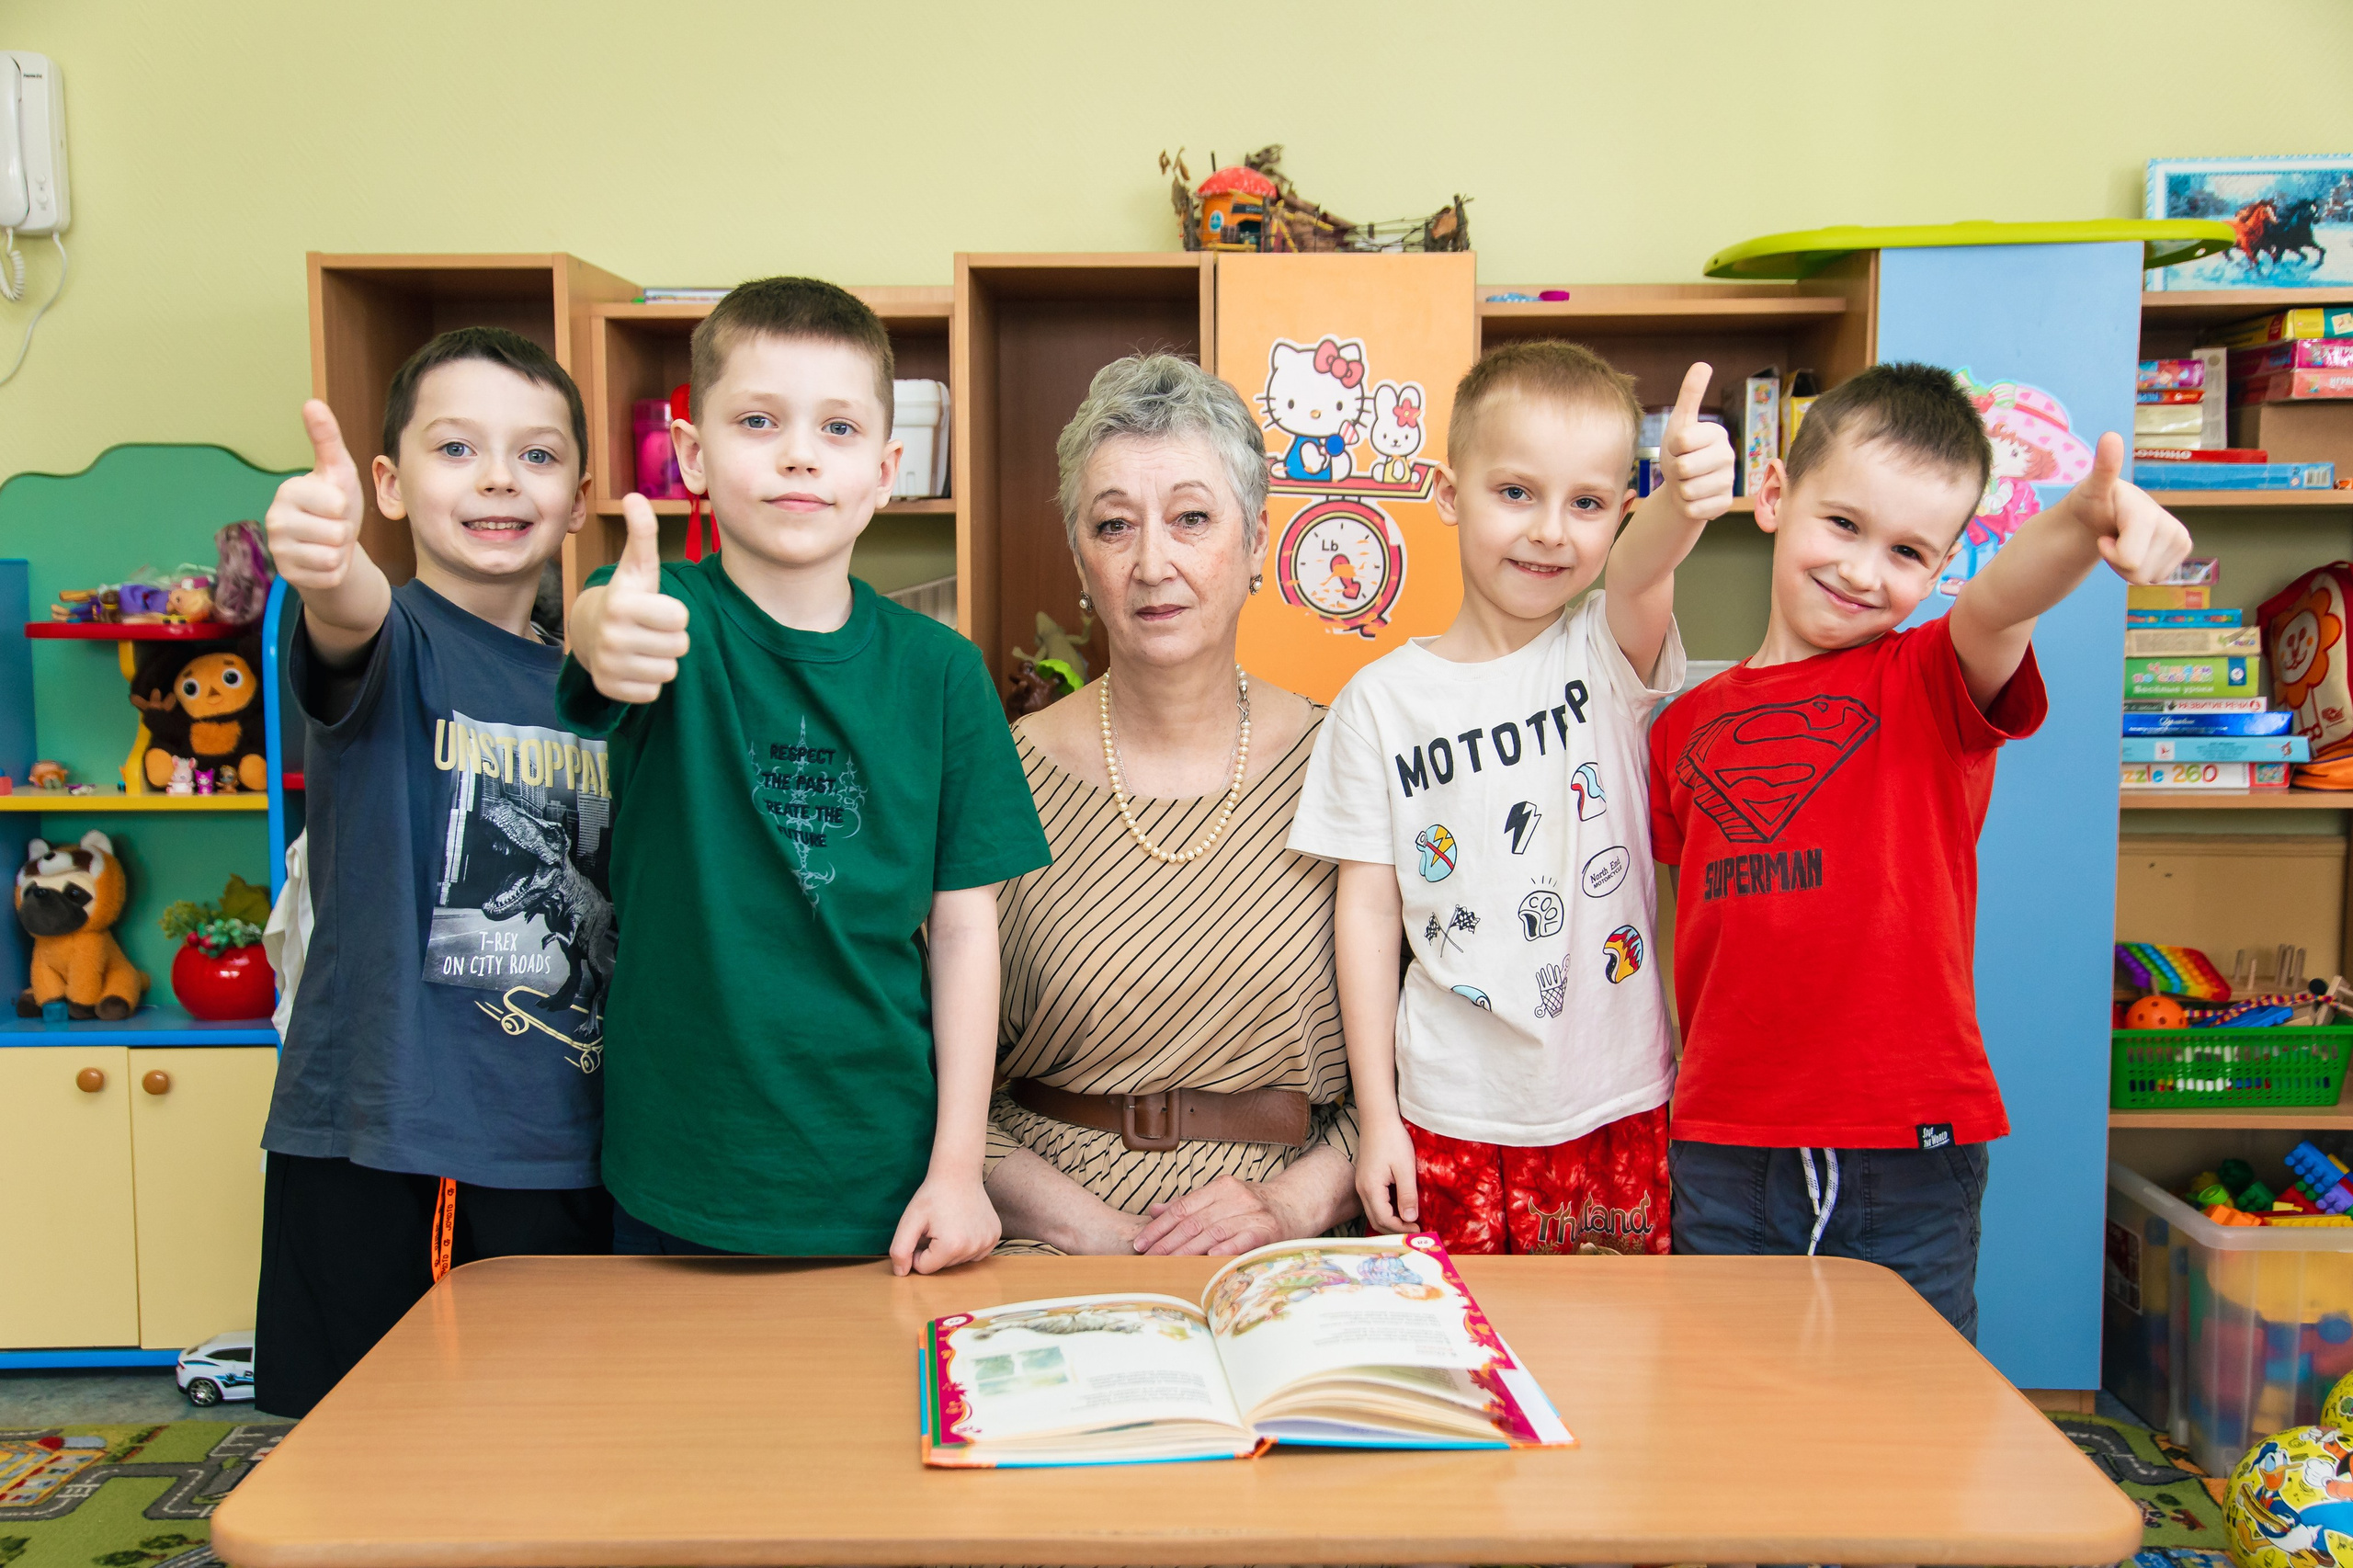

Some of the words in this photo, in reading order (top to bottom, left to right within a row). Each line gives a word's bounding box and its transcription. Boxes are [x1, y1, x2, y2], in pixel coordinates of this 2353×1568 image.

[1322, 539, 1339, 552] Lb
[770, 744, 835, 764] RESPECT
[762, 773, 790, 790] THE
[2172, 764, 2219, 783] 260
[763, 798, 811, 820] REATE
[815, 805, 845, 824] THE
[1589, 867, 1609, 884] North
[1609, 856, 1621, 871] End
[1593, 864, 1623, 890] MOTORCYCLE
[1703, 848, 1824, 903] SUPERMAN
[1529, 896, 1559, 934] COOL
[479, 931, 519, 952] T-REX
[442, 956, 465, 976] ON
[470, 955, 505, 977] CITY
[509, 954, 551, 975] ROADS
